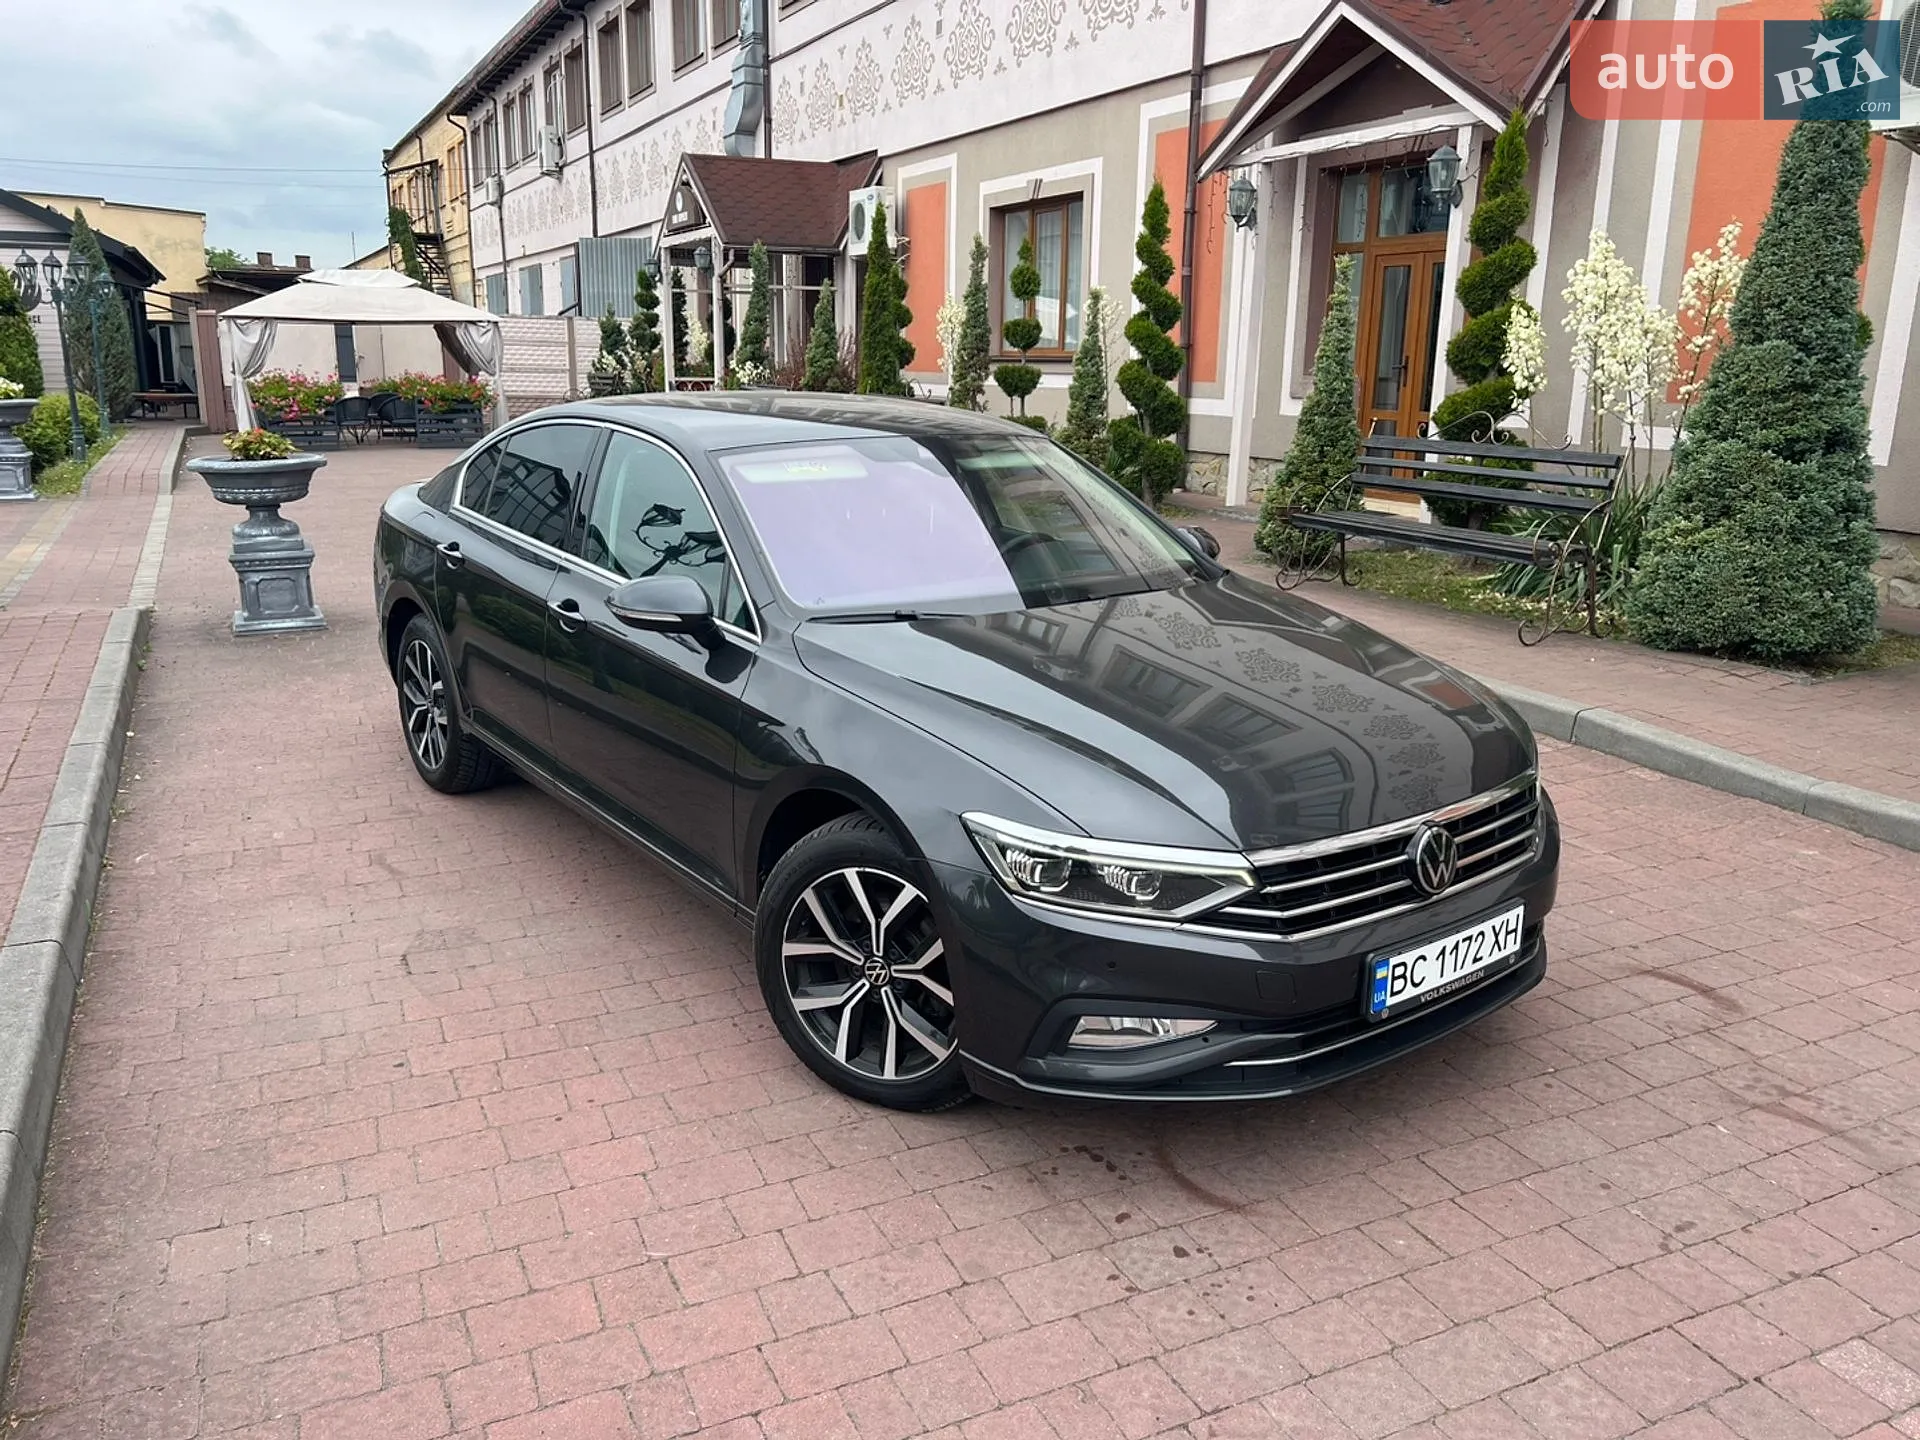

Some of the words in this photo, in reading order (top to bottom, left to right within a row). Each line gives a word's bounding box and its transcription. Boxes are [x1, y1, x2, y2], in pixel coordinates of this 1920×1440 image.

[1389, 955, 1427, 998] BC
[1435, 930, 1486, 979] 1172
[1488, 913, 1520, 957] XH
[1374, 991, 1386, 1003] UA
[1420, 969, 1485, 1003] VOLKSWAGEN
